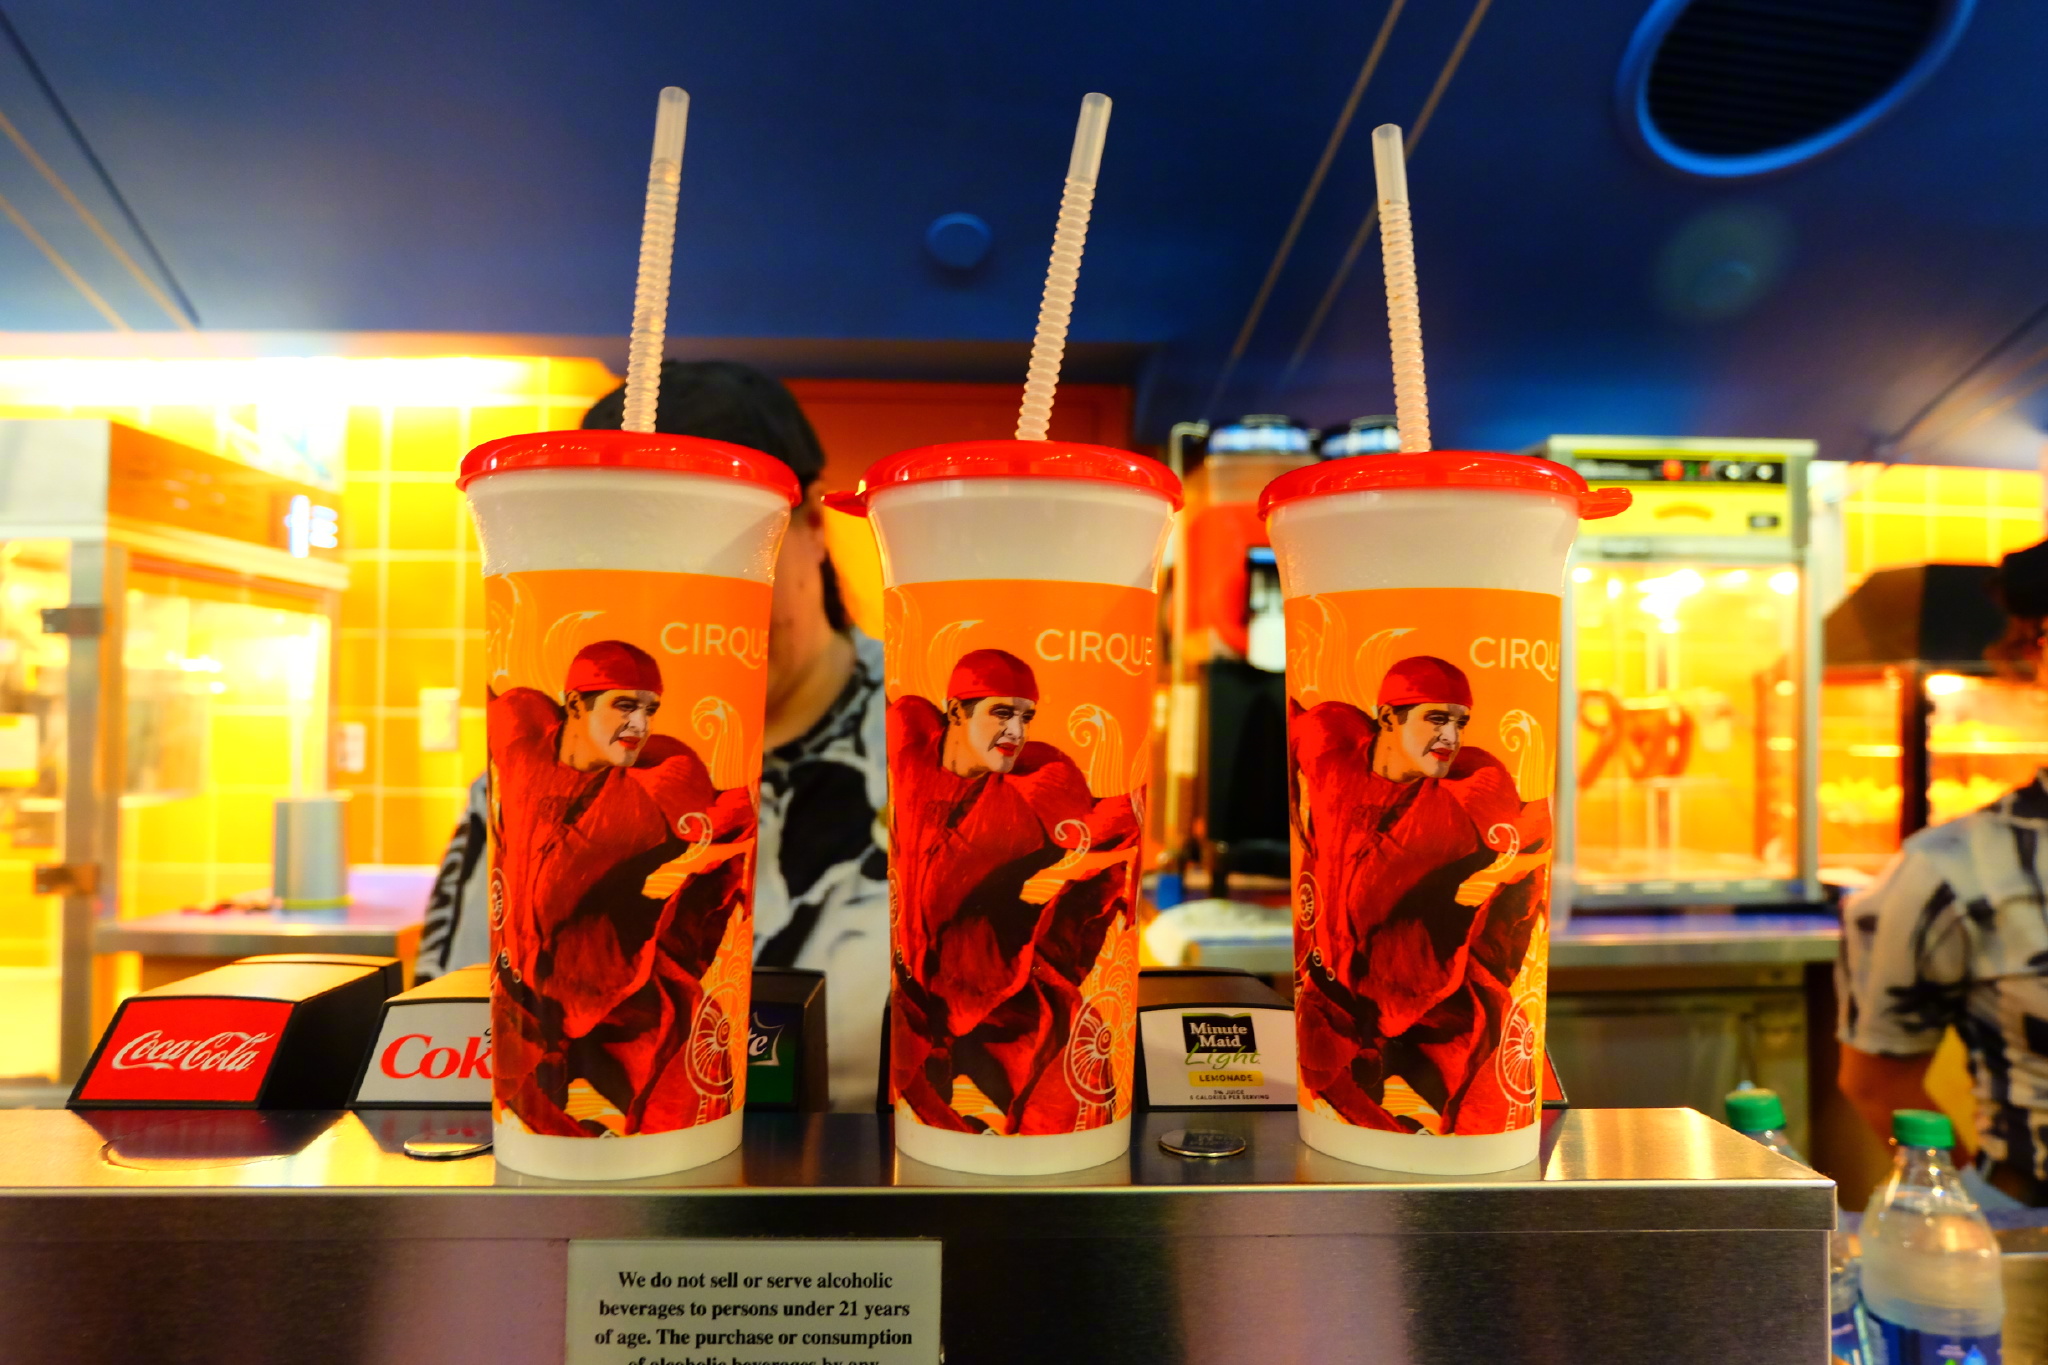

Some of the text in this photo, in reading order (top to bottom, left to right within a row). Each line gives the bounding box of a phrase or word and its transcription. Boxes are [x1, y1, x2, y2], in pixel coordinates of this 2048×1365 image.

[1035, 628, 1153, 677] CIRQUE
[1469, 636, 1560, 682] CIRQU
[1189, 1022, 1248, 1035] Minute
[1198, 1034, 1242, 1048] Maid
[380, 1033, 492, 1079] Cok
[1184, 1042, 1262, 1070] Light
[1198, 1074, 1254, 1082] LEMONADE
[618, 1271, 893, 1289] We do not sell or serve alcoholic
[599, 1300, 911, 1321] beverages to persons under 21 years
[594, 1328, 913, 1350] of age. The purchase or consumption
